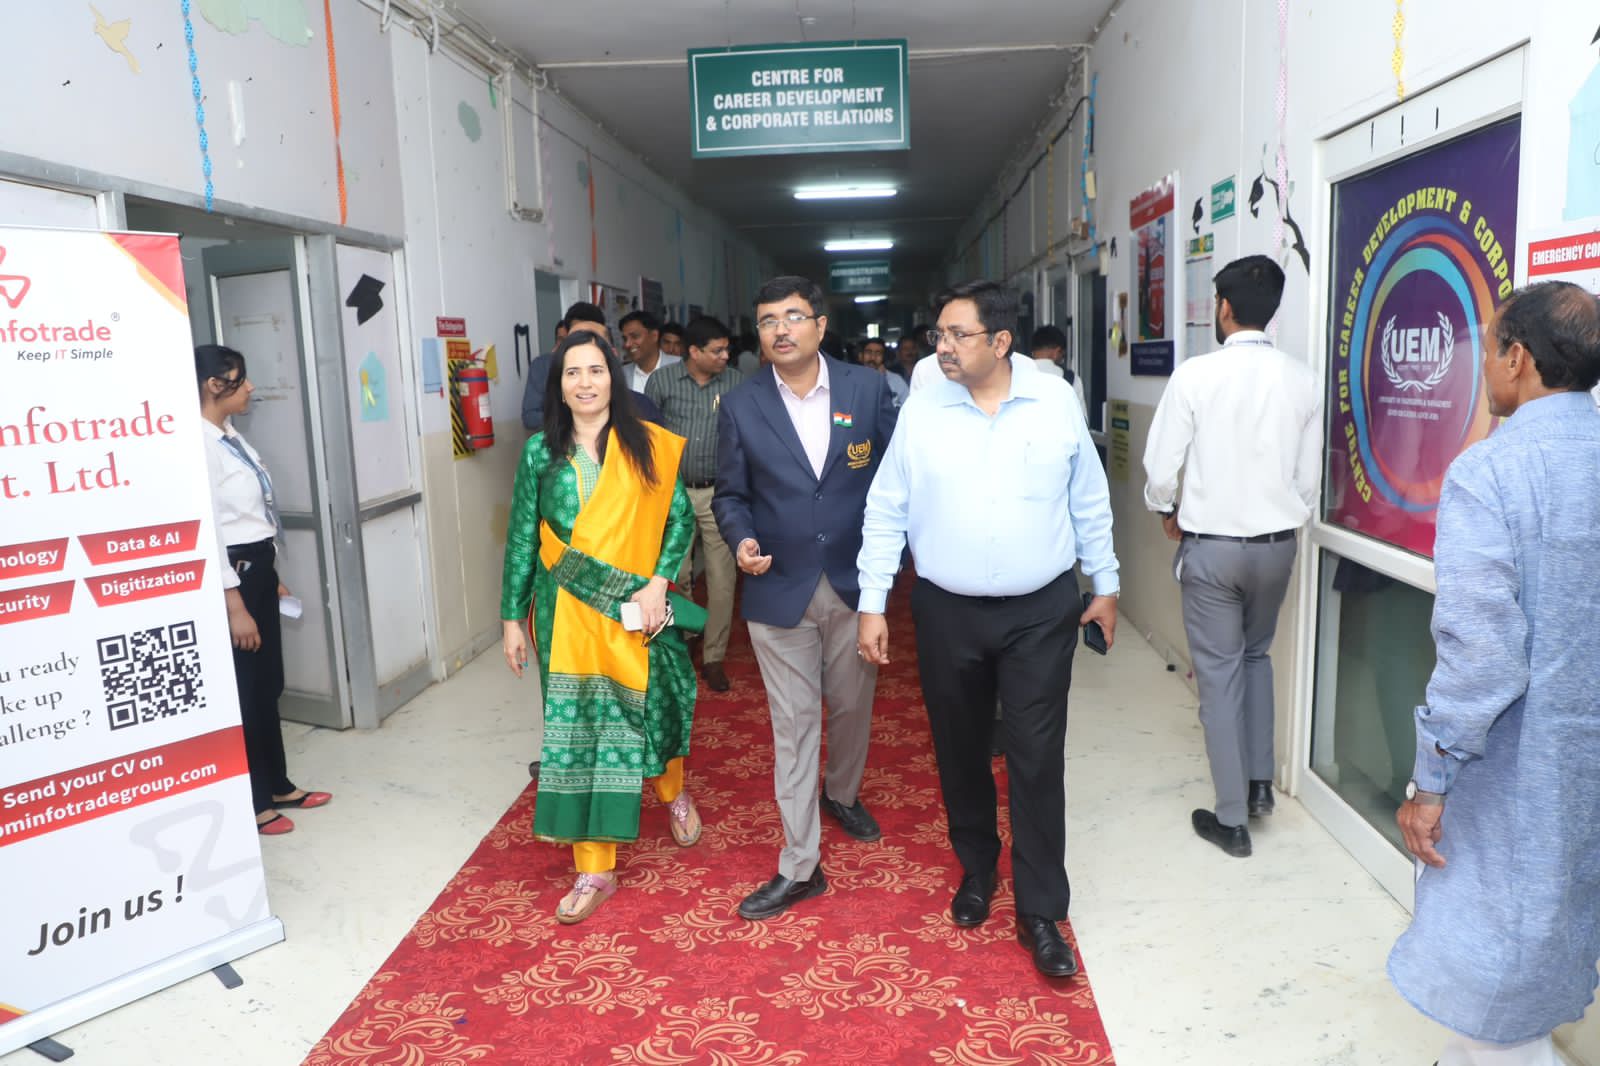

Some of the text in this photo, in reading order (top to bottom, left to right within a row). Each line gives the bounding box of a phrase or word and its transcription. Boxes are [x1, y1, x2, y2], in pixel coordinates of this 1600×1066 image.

[751, 67, 844, 87] CENTRE FOR
[713, 87, 885, 110] CAREER DEVELOPMENT
[706, 108, 894, 132] & CORPORATE RELATIONS
[1362, 187, 1458, 265] DEVELOPMENT
[1459, 200, 1473, 225] &
[1473, 216, 1514, 301] CORPO
[1532, 244, 1584, 267] EMERGENCY
[1339, 267, 1365, 358] CAREER
[17, 347, 113, 363] Keep IT Simple
[1390, 327, 1441, 362] UEM
[1338, 369, 1350, 414] FOR
[0, 400, 175, 447] nfotrade
[0, 451, 131, 499] t. Ltd.
[106, 531, 181, 554] Data & AI
[101, 570, 196, 597] Digitization
[20, 651, 79, 679] ready
[0, 691, 63, 715] ke up
[82, 709, 91, 726] ?
[3, 754, 164, 809] Send your CV on
[27, 874, 185, 956] Join us !
